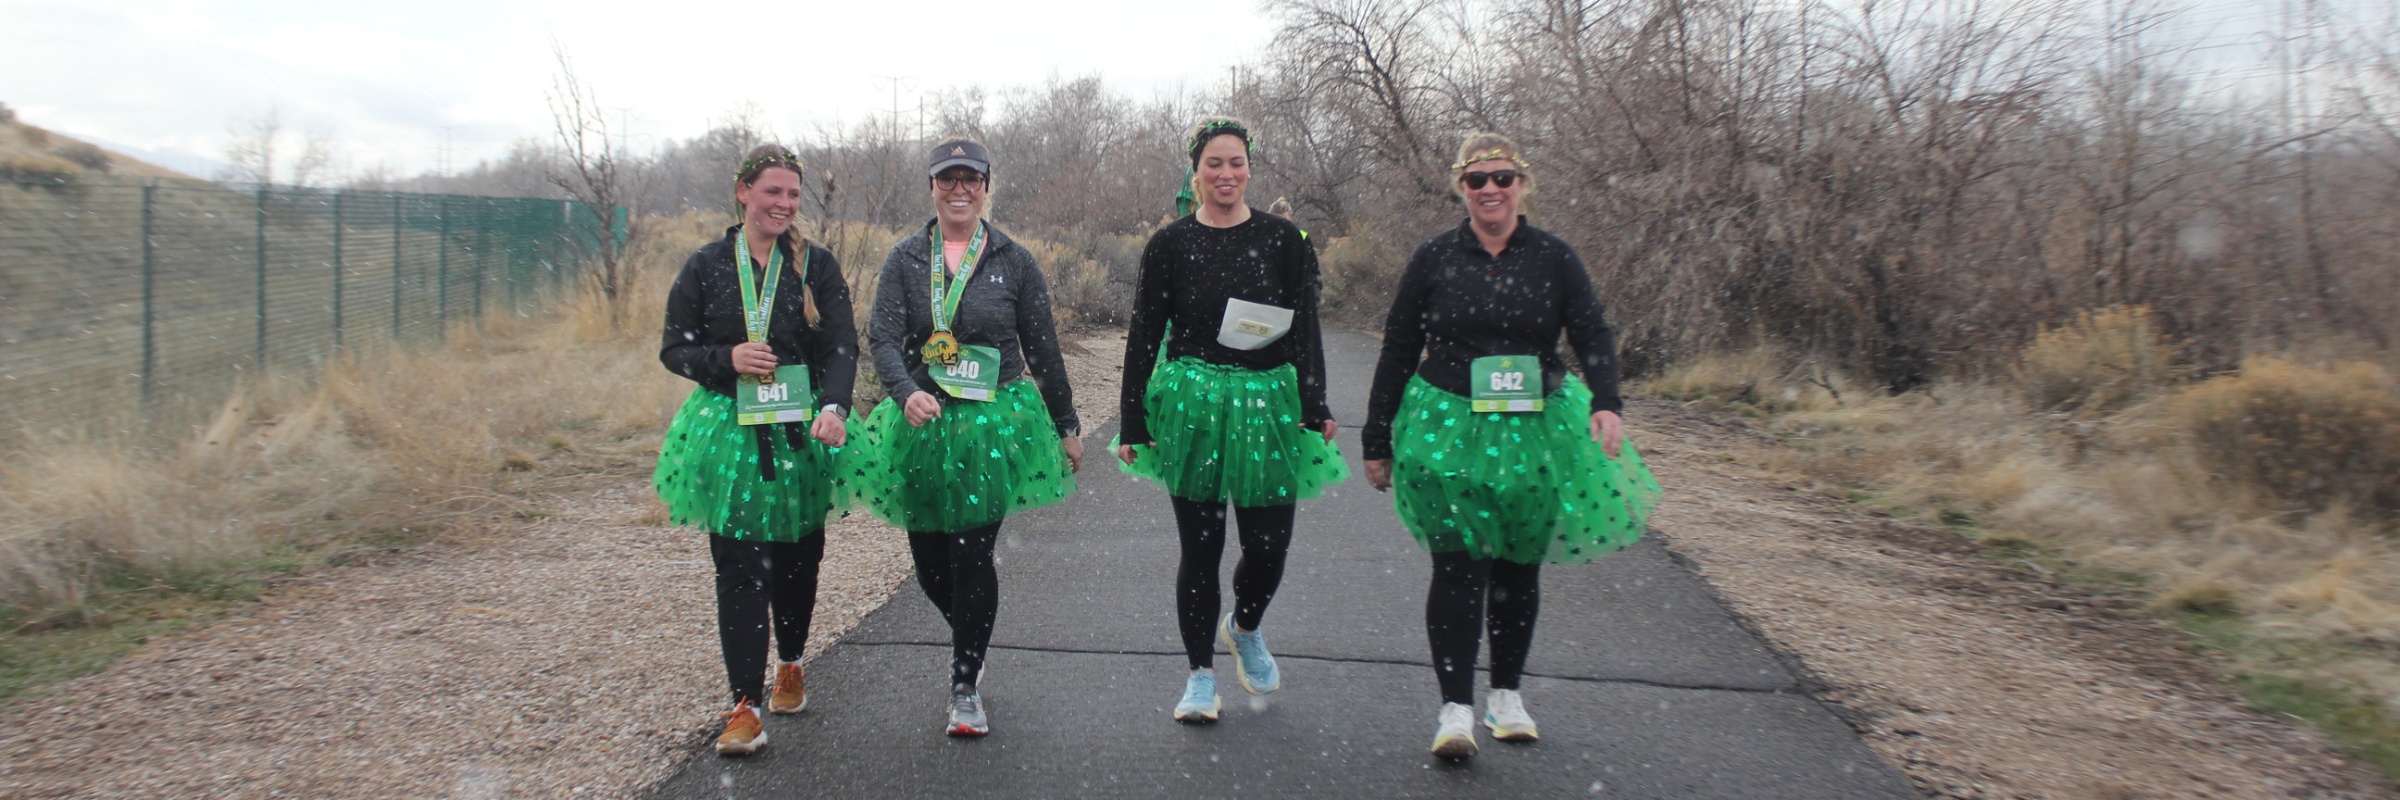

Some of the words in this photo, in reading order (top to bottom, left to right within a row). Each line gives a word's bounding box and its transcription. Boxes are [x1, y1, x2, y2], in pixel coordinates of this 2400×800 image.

[932, 254, 942, 272] lucky
[957, 263, 972, 281] lucky
[933, 273, 942, 282] 13
[1490, 371, 1524, 391] 642
[757, 382, 788, 402] 641
